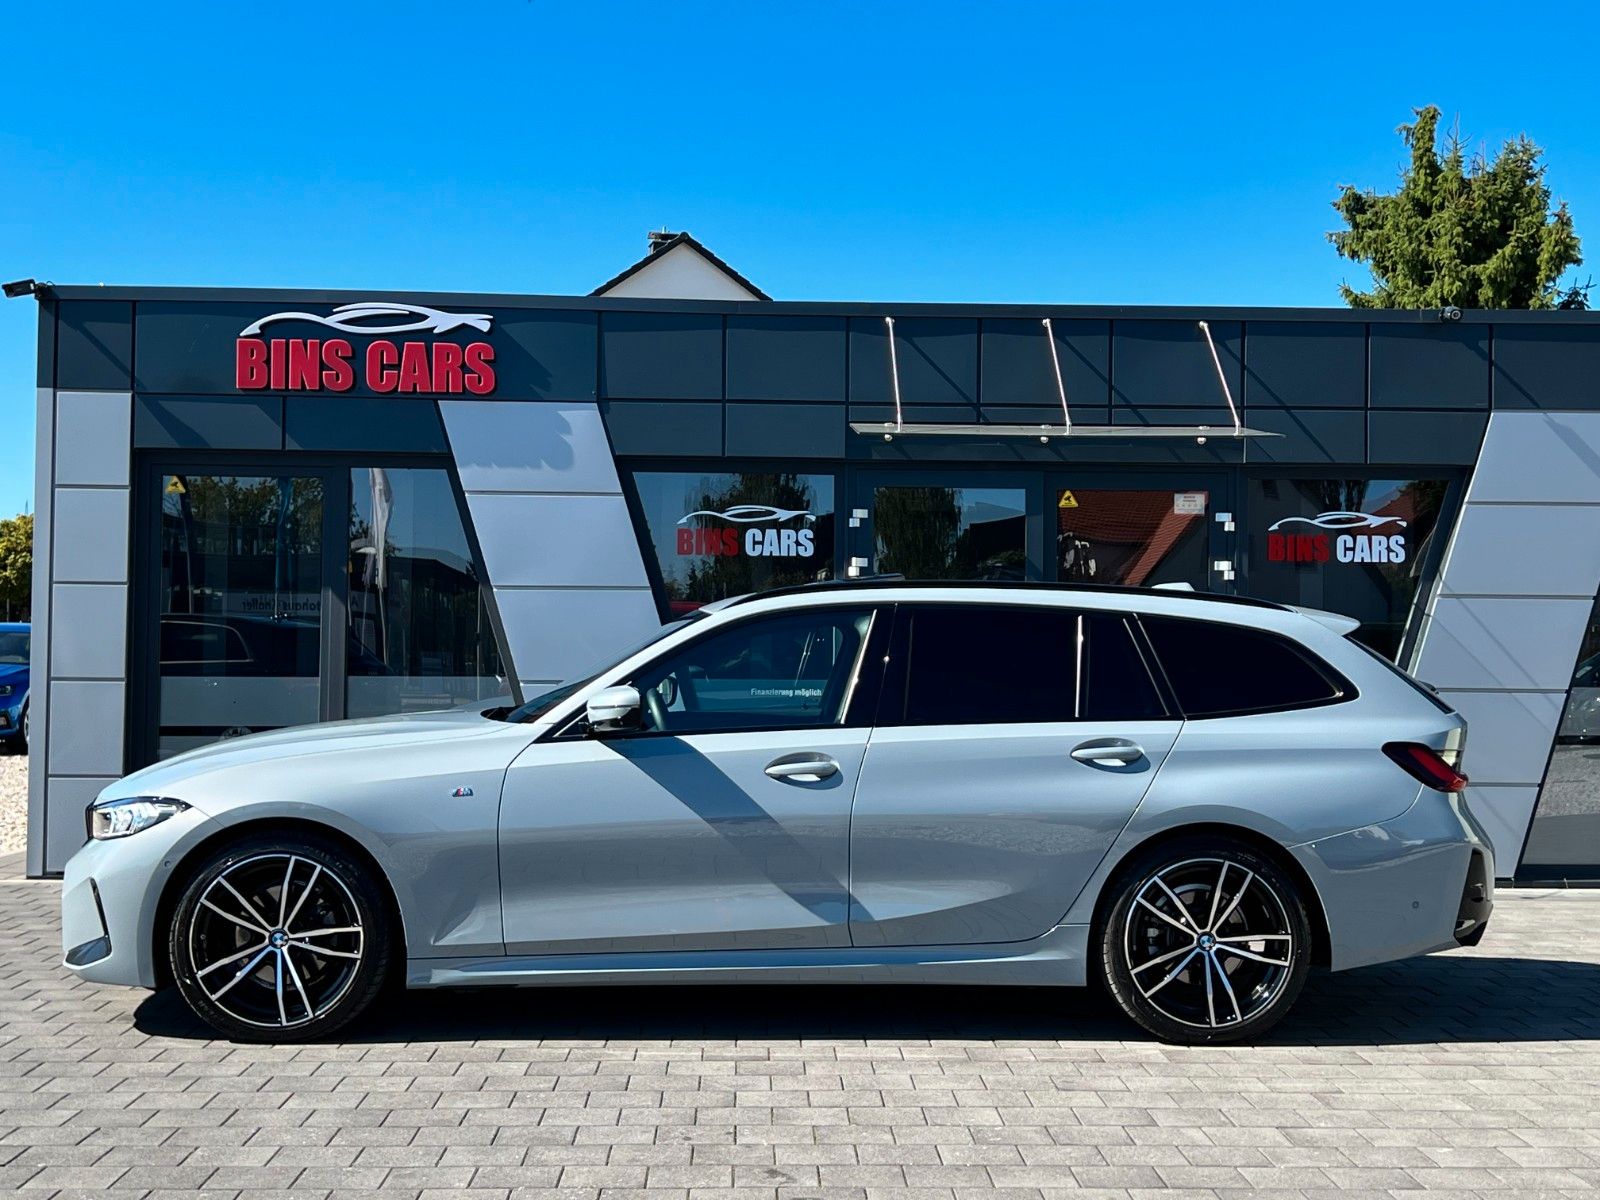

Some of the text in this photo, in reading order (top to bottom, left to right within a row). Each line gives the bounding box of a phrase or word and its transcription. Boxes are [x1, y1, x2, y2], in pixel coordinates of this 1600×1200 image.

[236, 338, 495, 394] BINS CARS
[677, 528, 814, 557] BINS CARS
[1268, 533, 1406, 563] BINS CARS
[750, 688, 822, 697] Finanzierung möglich
